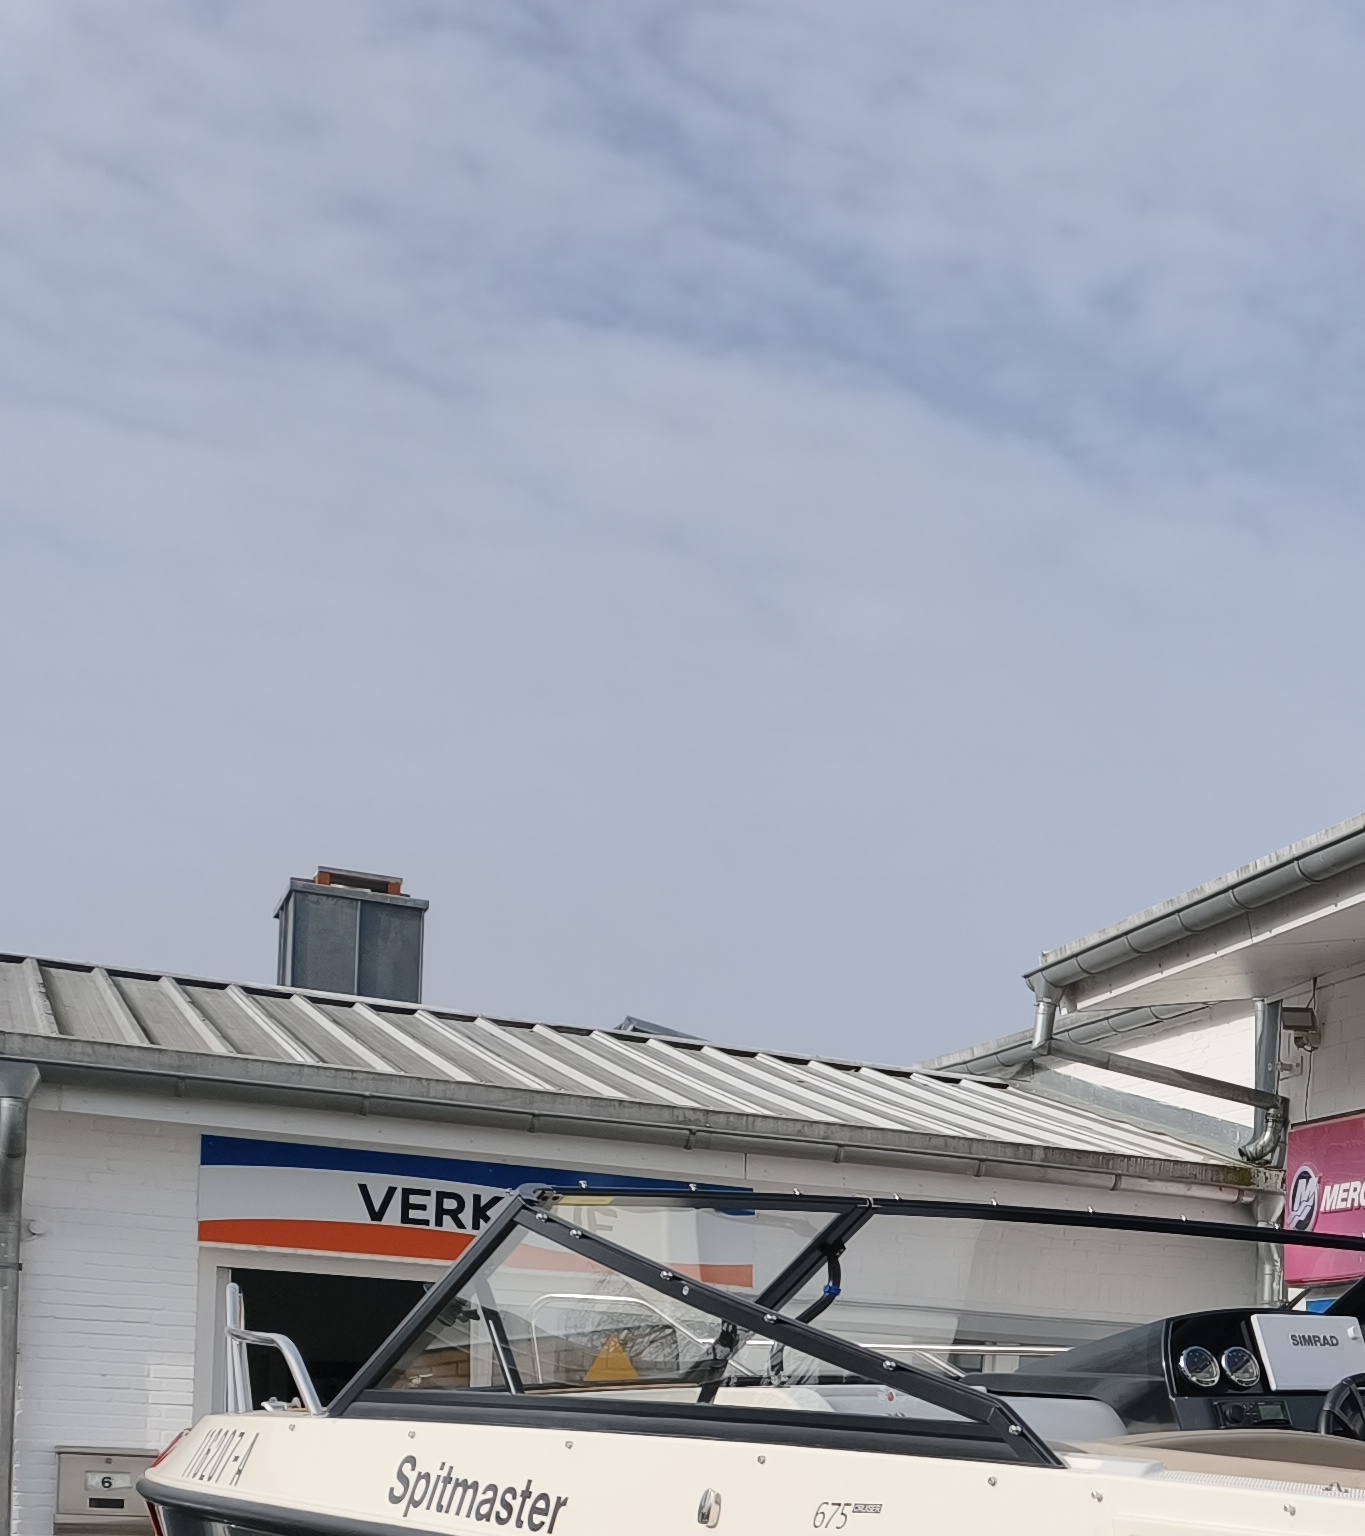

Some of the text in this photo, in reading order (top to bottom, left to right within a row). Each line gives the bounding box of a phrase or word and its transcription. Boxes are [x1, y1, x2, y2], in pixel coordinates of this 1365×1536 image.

[1290, 1333, 1340, 1348] SIMRAD
[101, 1476, 113, 1489] 6
[388, 1455, 569, 1535] Spitmaster
[813, 1501, 852, 1530] 675
